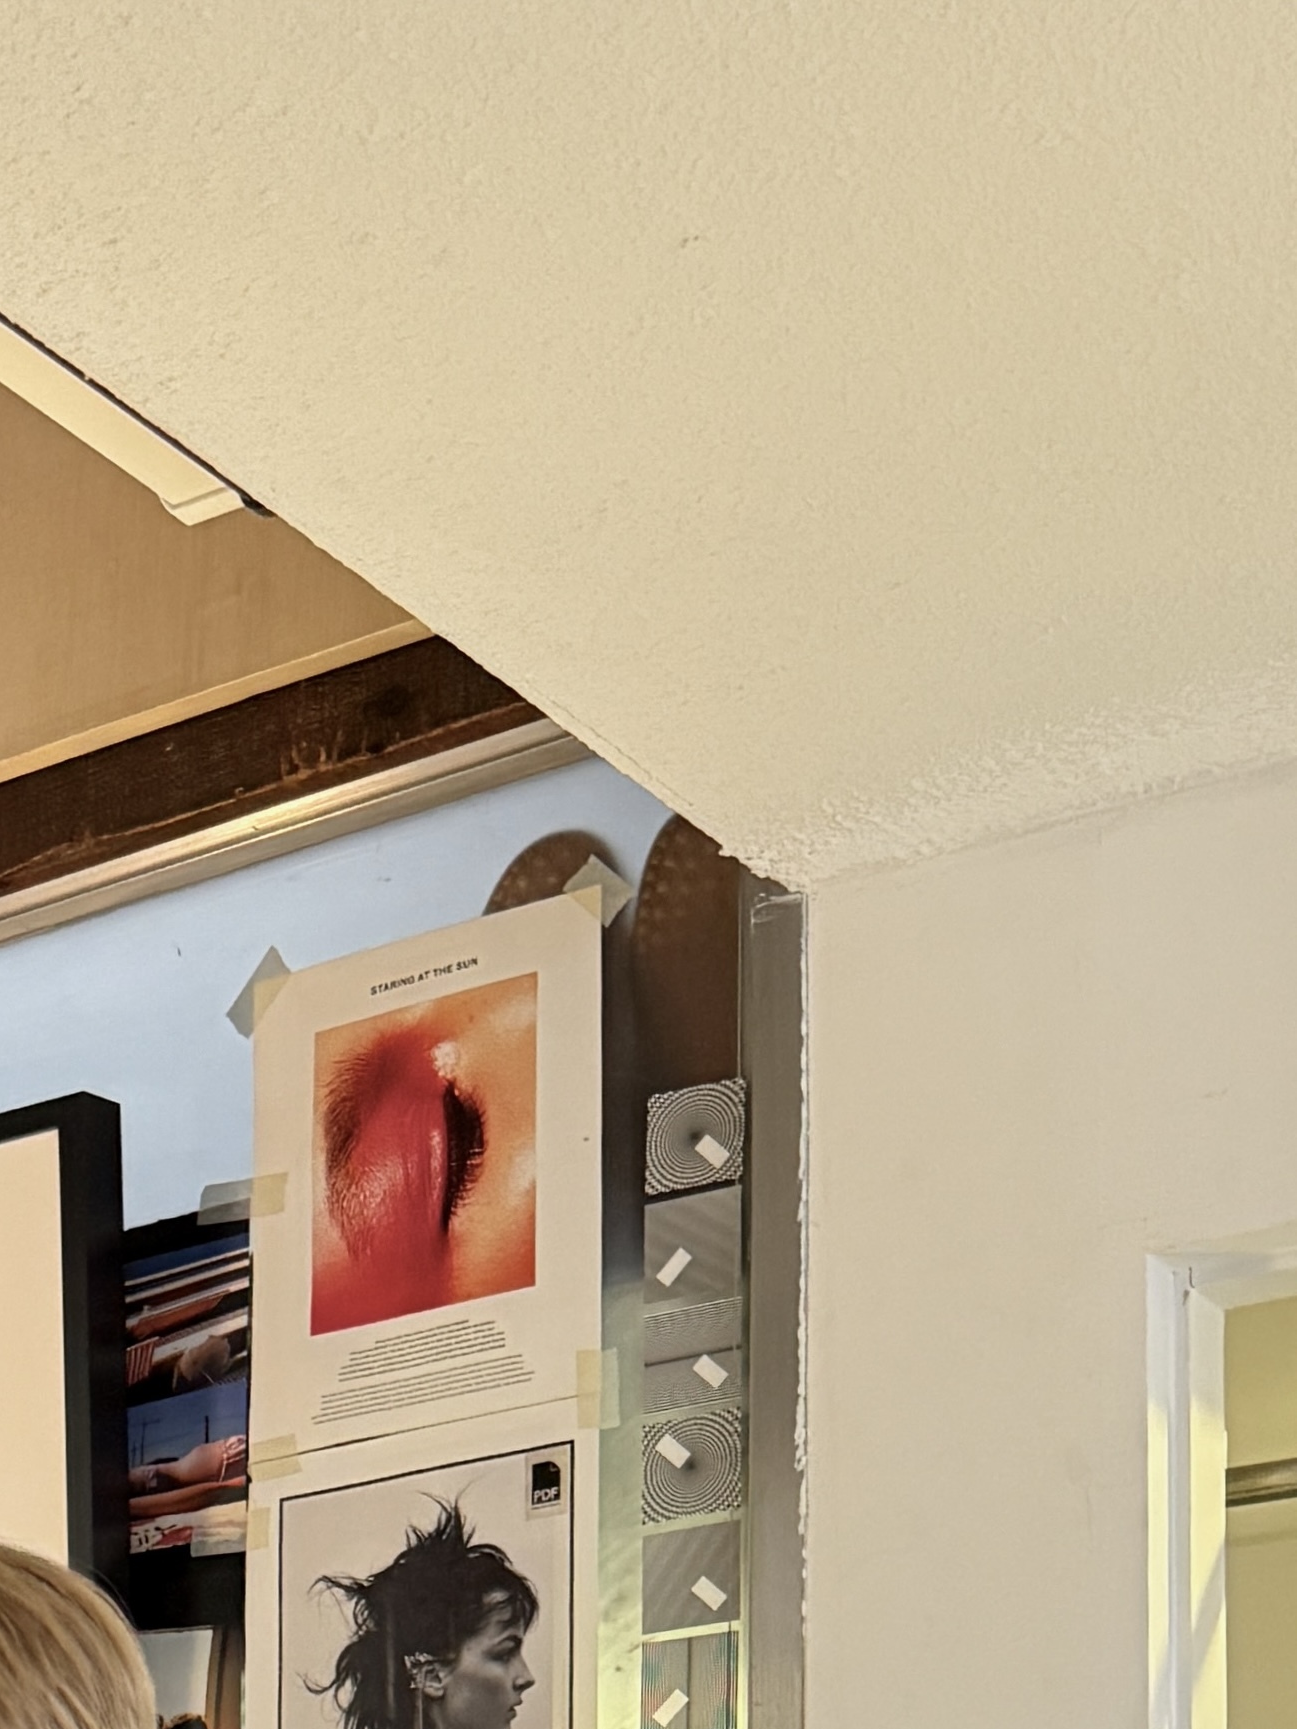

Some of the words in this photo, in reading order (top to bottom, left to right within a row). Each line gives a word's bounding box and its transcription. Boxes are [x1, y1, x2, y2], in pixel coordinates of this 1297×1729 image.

[370, 975, 416, 996] STARING
[417, 970, 431, 983] AT
[432, 963, 454, 978] THE
[455, 957, 479, 971] SUN
[533, 1486, 559, 1503] PDF
